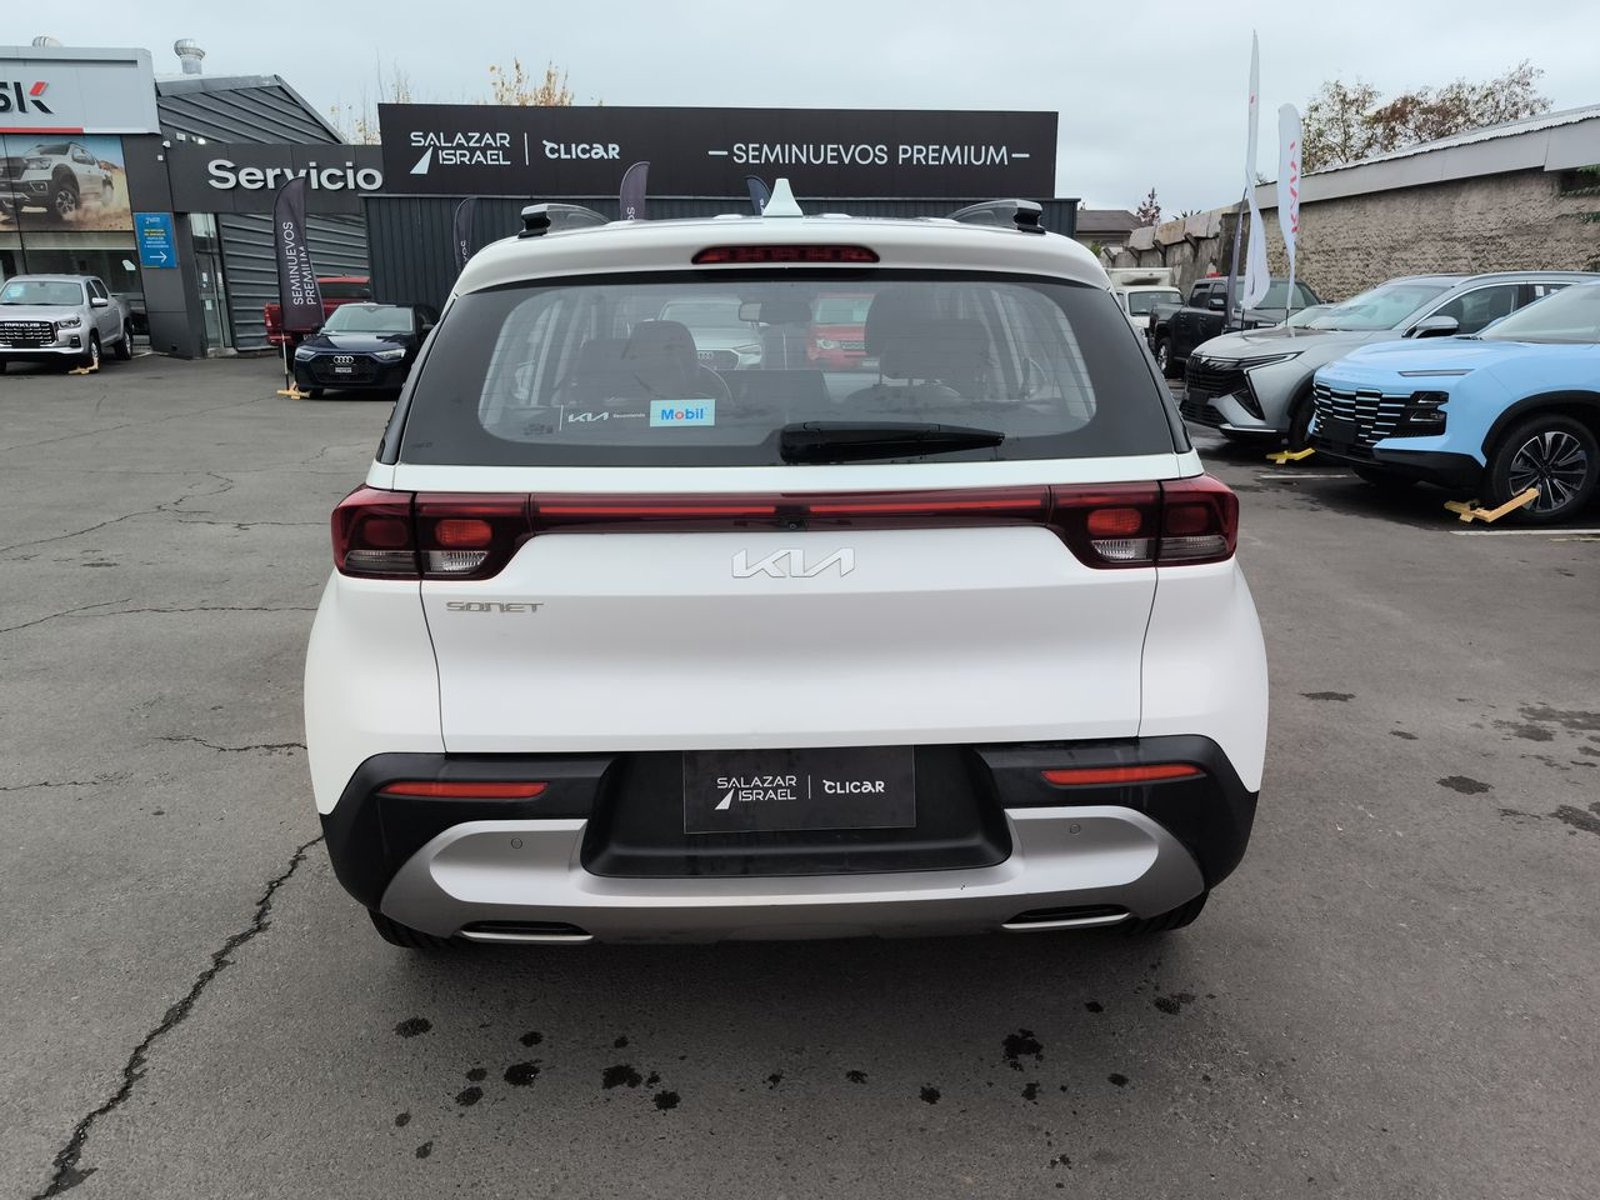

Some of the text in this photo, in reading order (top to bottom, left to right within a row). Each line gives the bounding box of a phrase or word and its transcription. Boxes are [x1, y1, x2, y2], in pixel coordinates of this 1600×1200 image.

[410, 132, 510, 147] SALAZAR
[438, 150, 511, 165] ISRAEL
[733, 143, 1008, 165] SEMINUEVOS PREMIUM
[282, 221, 304, 305] SEMINUEVOS
[661, 409, 704, 420] Mobil
[732, 548, 855, 578] KIA
[446, 602, 544, 613] SONET
[717, 776, 796, 789] SALAZAR
[738, 789, 796, 801] ISRAEL
